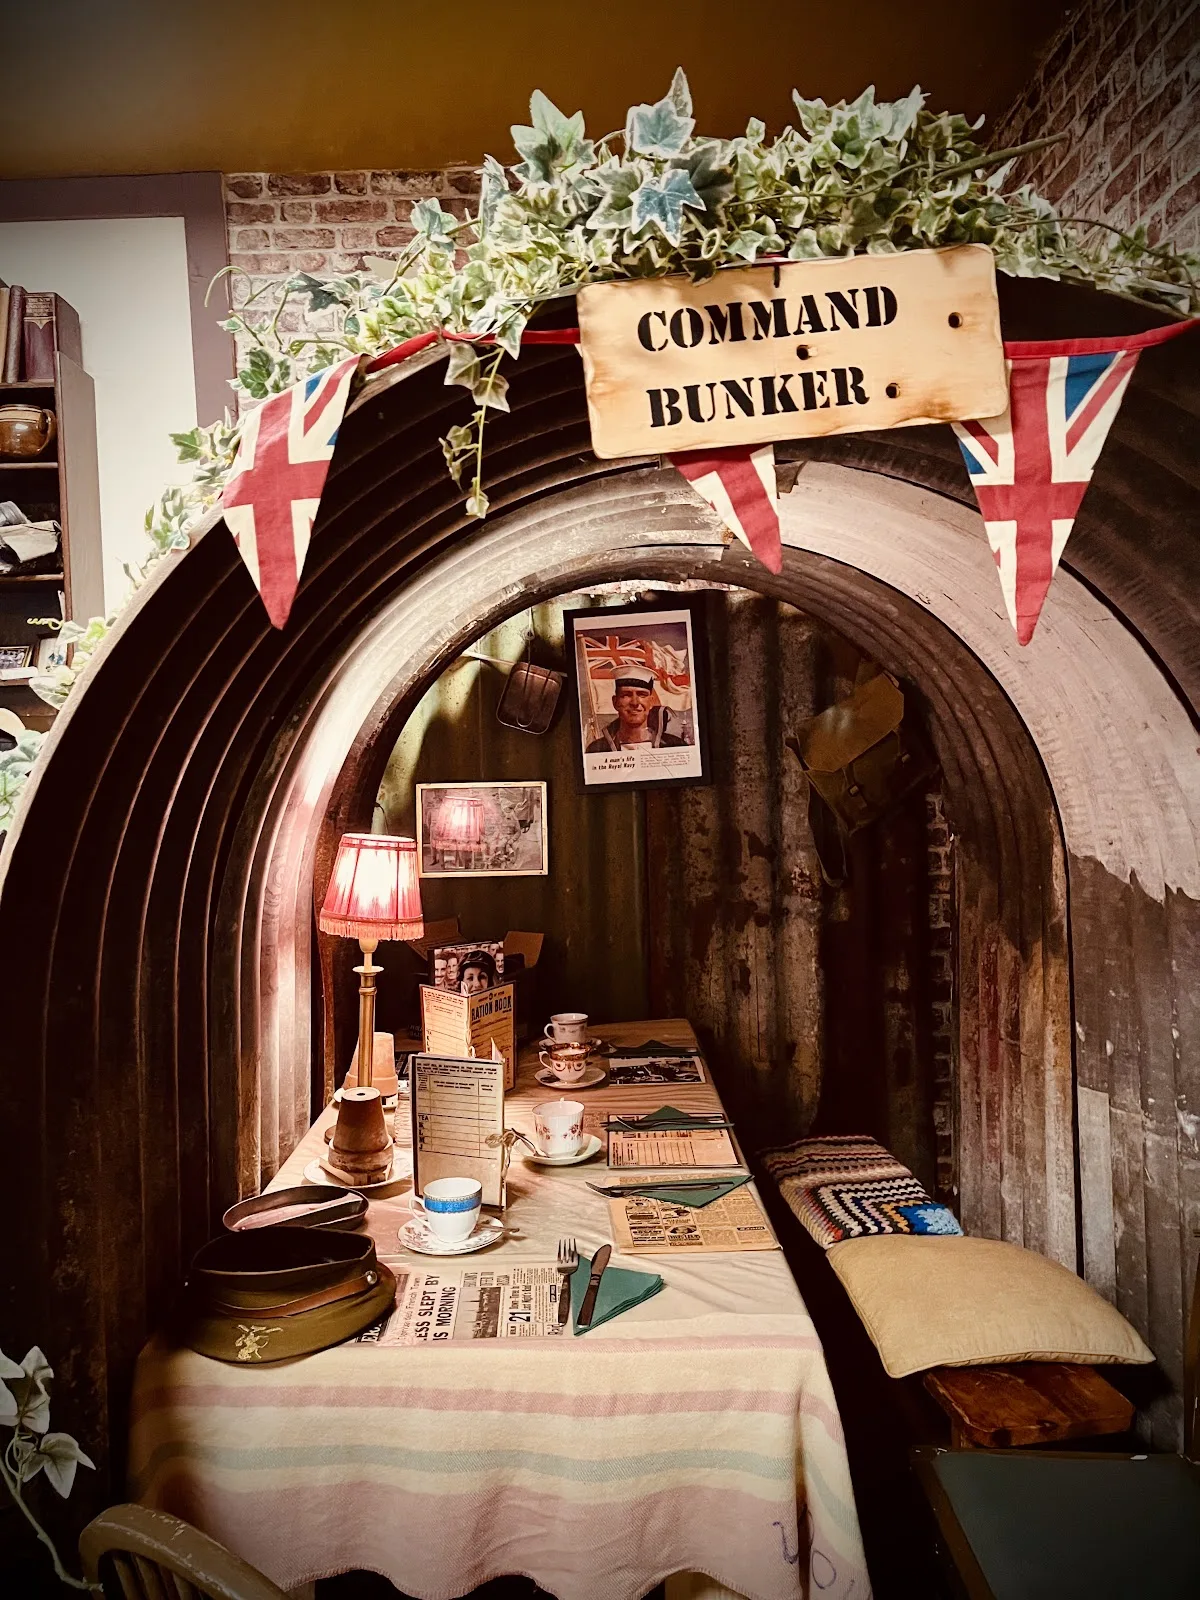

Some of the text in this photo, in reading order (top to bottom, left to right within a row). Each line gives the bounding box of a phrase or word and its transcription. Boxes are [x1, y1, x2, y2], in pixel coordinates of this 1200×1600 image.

[637, 285, 898, 352] COMMAND
[646, 366, 870, 428] BUNKER
[472, 1002, 493, 1021] RATION
[495, 996, 512, 1012] BOOK
[414, 1274, 440, 1340] ESS SLEPT BY
[435, 1286, 457, 1326] MORNING
[508, 1311, 531, 1322] 21
